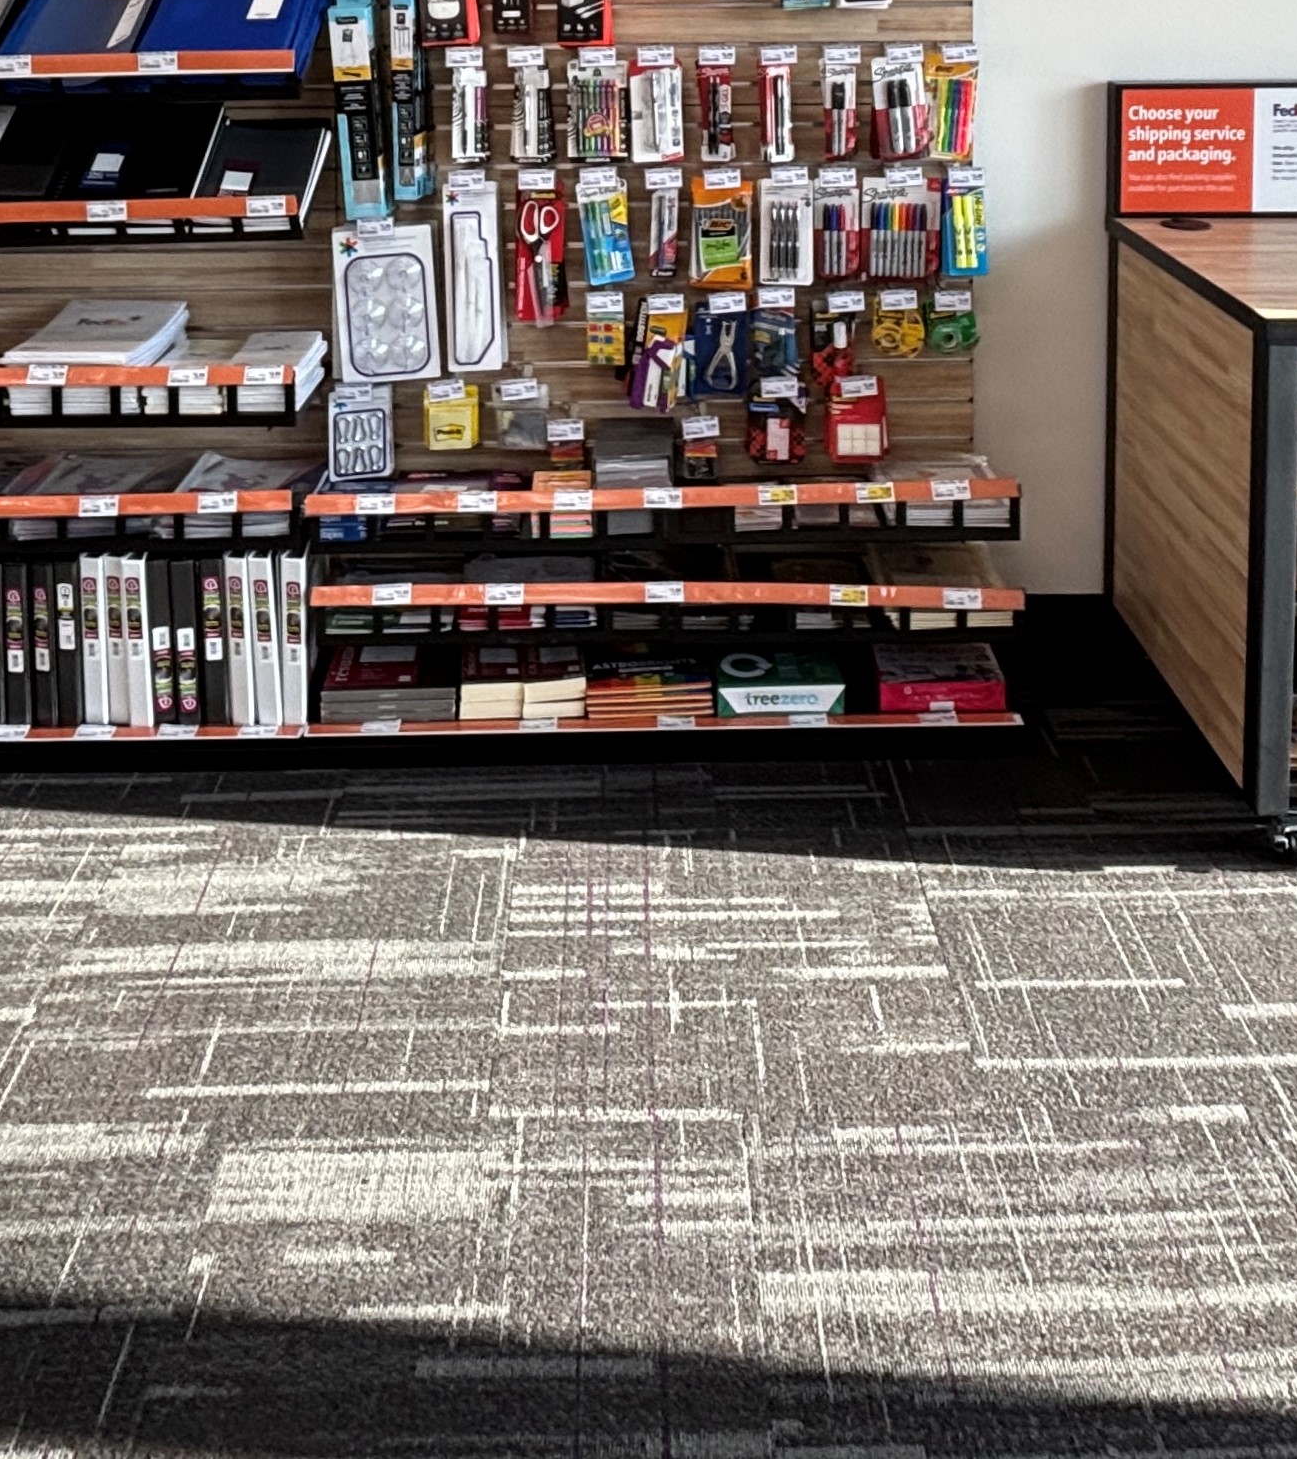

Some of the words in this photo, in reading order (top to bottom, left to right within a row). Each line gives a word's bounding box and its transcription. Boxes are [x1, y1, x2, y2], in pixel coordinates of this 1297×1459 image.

[1128, 105, 1183, 121] Choose
[1184, 108, 1220, 124] your
[1128, 125, 1191, 145] shipping
[1193, 125, 1246, 141] service
[1128, 146, 1155, 161] and
[1157, 146, 1237, 165] packaging.
[862, 187, 909, 203] Sharpie
[744, 690, 821, 708] treezero
